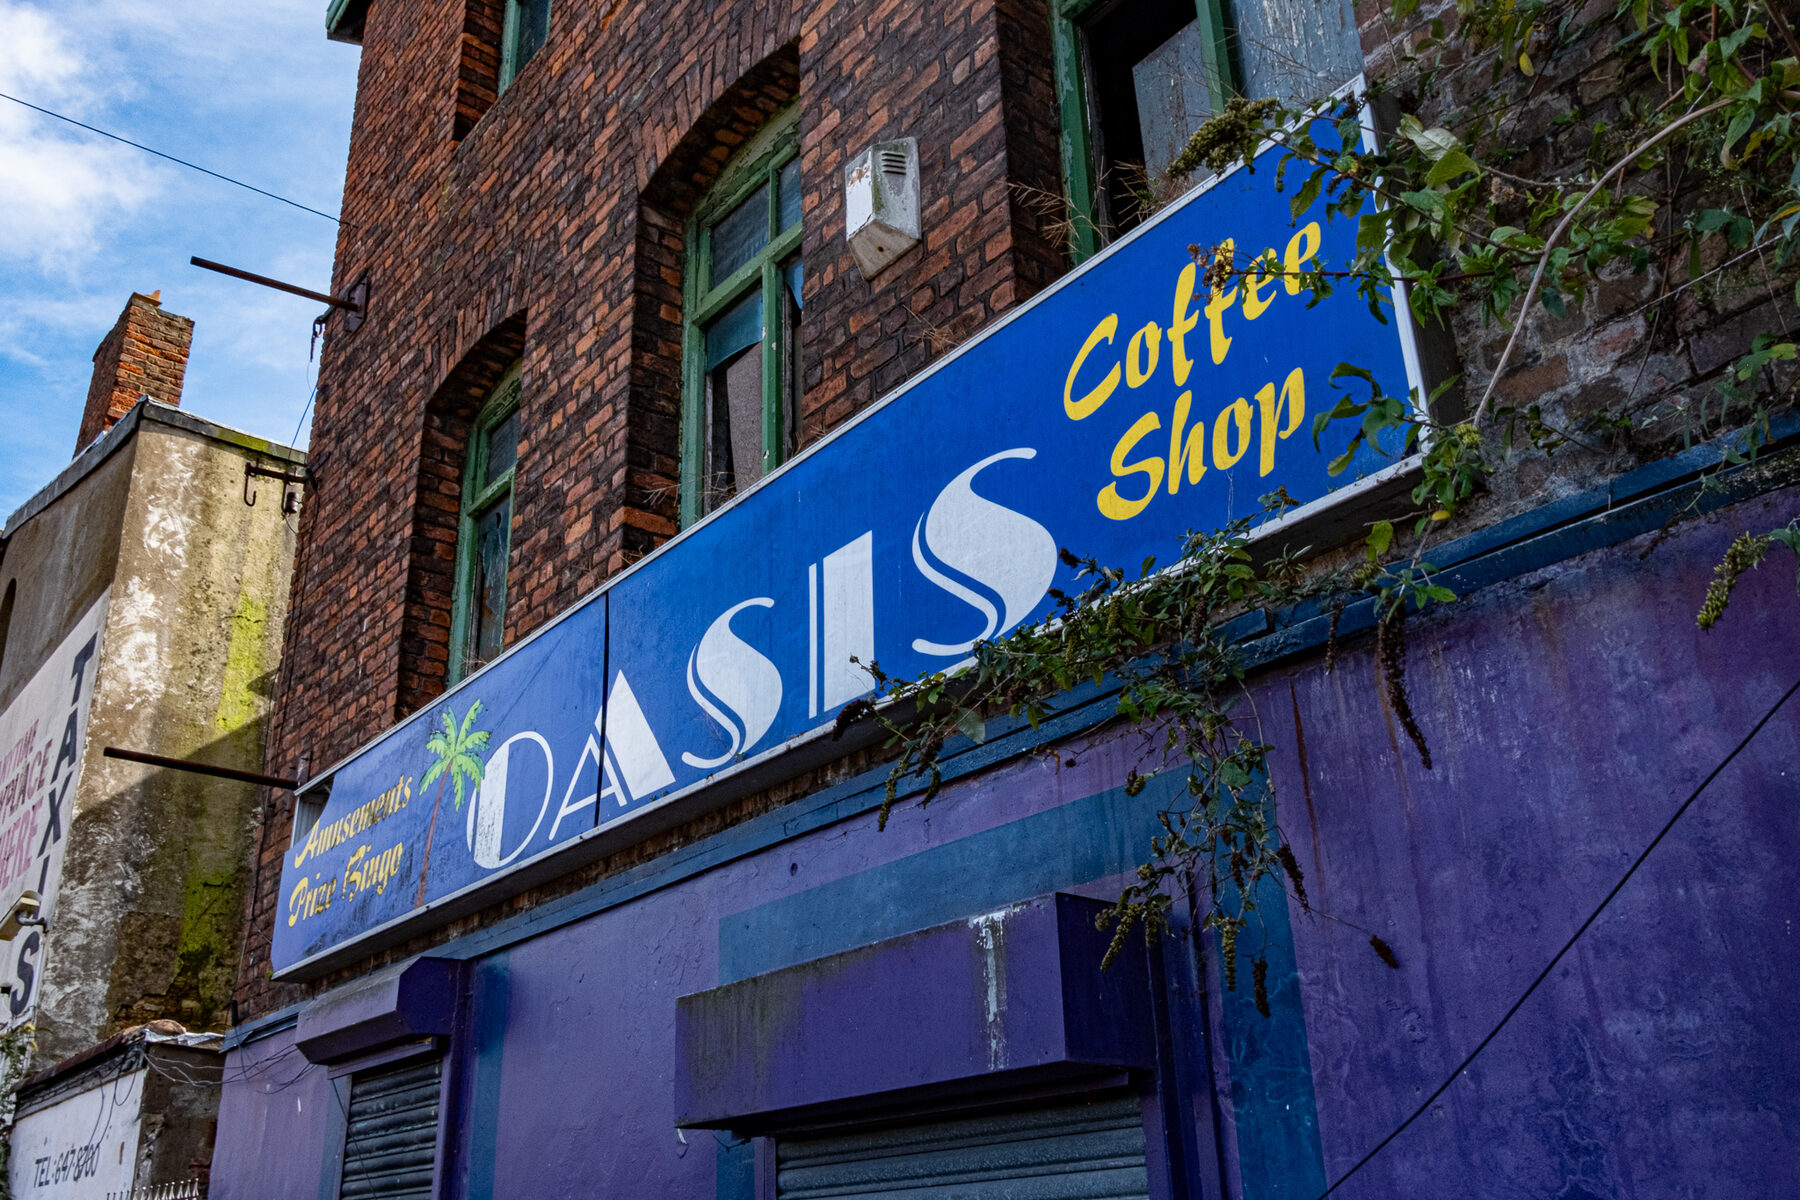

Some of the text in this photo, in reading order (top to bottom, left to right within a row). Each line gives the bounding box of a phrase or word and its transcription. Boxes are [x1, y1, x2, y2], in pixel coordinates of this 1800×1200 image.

[1064, 221, 1321, 421] Coffee
[1097, 367, 1305, 521] Shop
[466, 447, 1058, 870] OASIS
[288, 841, 404, 928] Prize Bingo
[294, 773, 413, 869] Amusements
